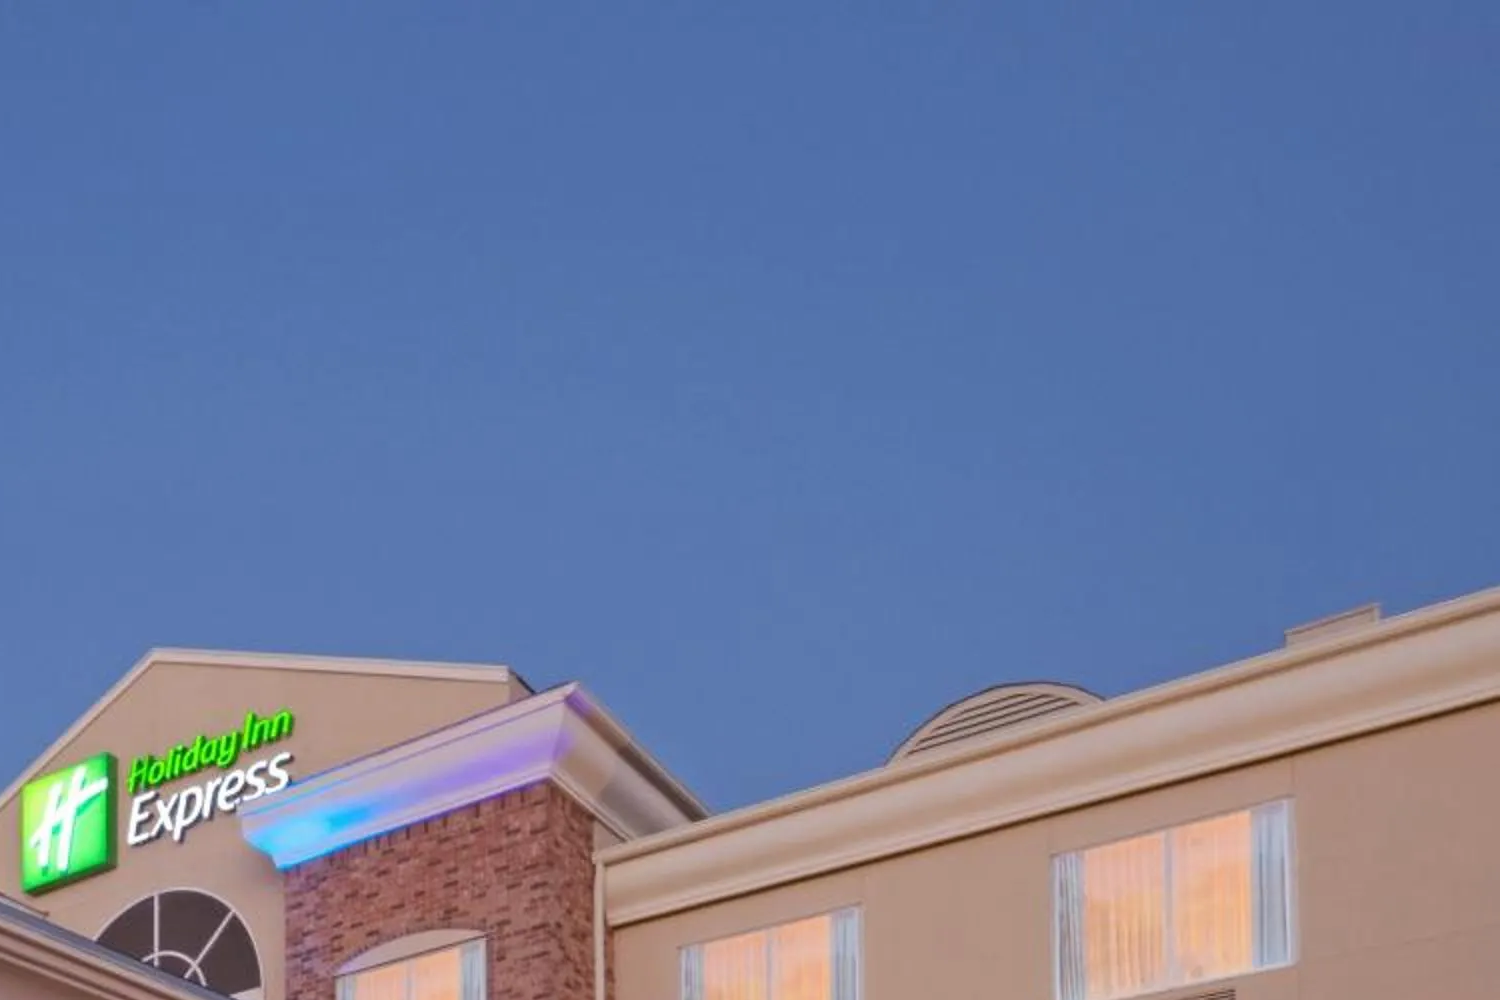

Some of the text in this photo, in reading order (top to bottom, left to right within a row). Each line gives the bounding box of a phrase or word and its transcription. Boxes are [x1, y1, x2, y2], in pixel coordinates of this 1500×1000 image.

[127, 709, 292, 792] Holiday Inn
[127, 752, 292, 845] Express
